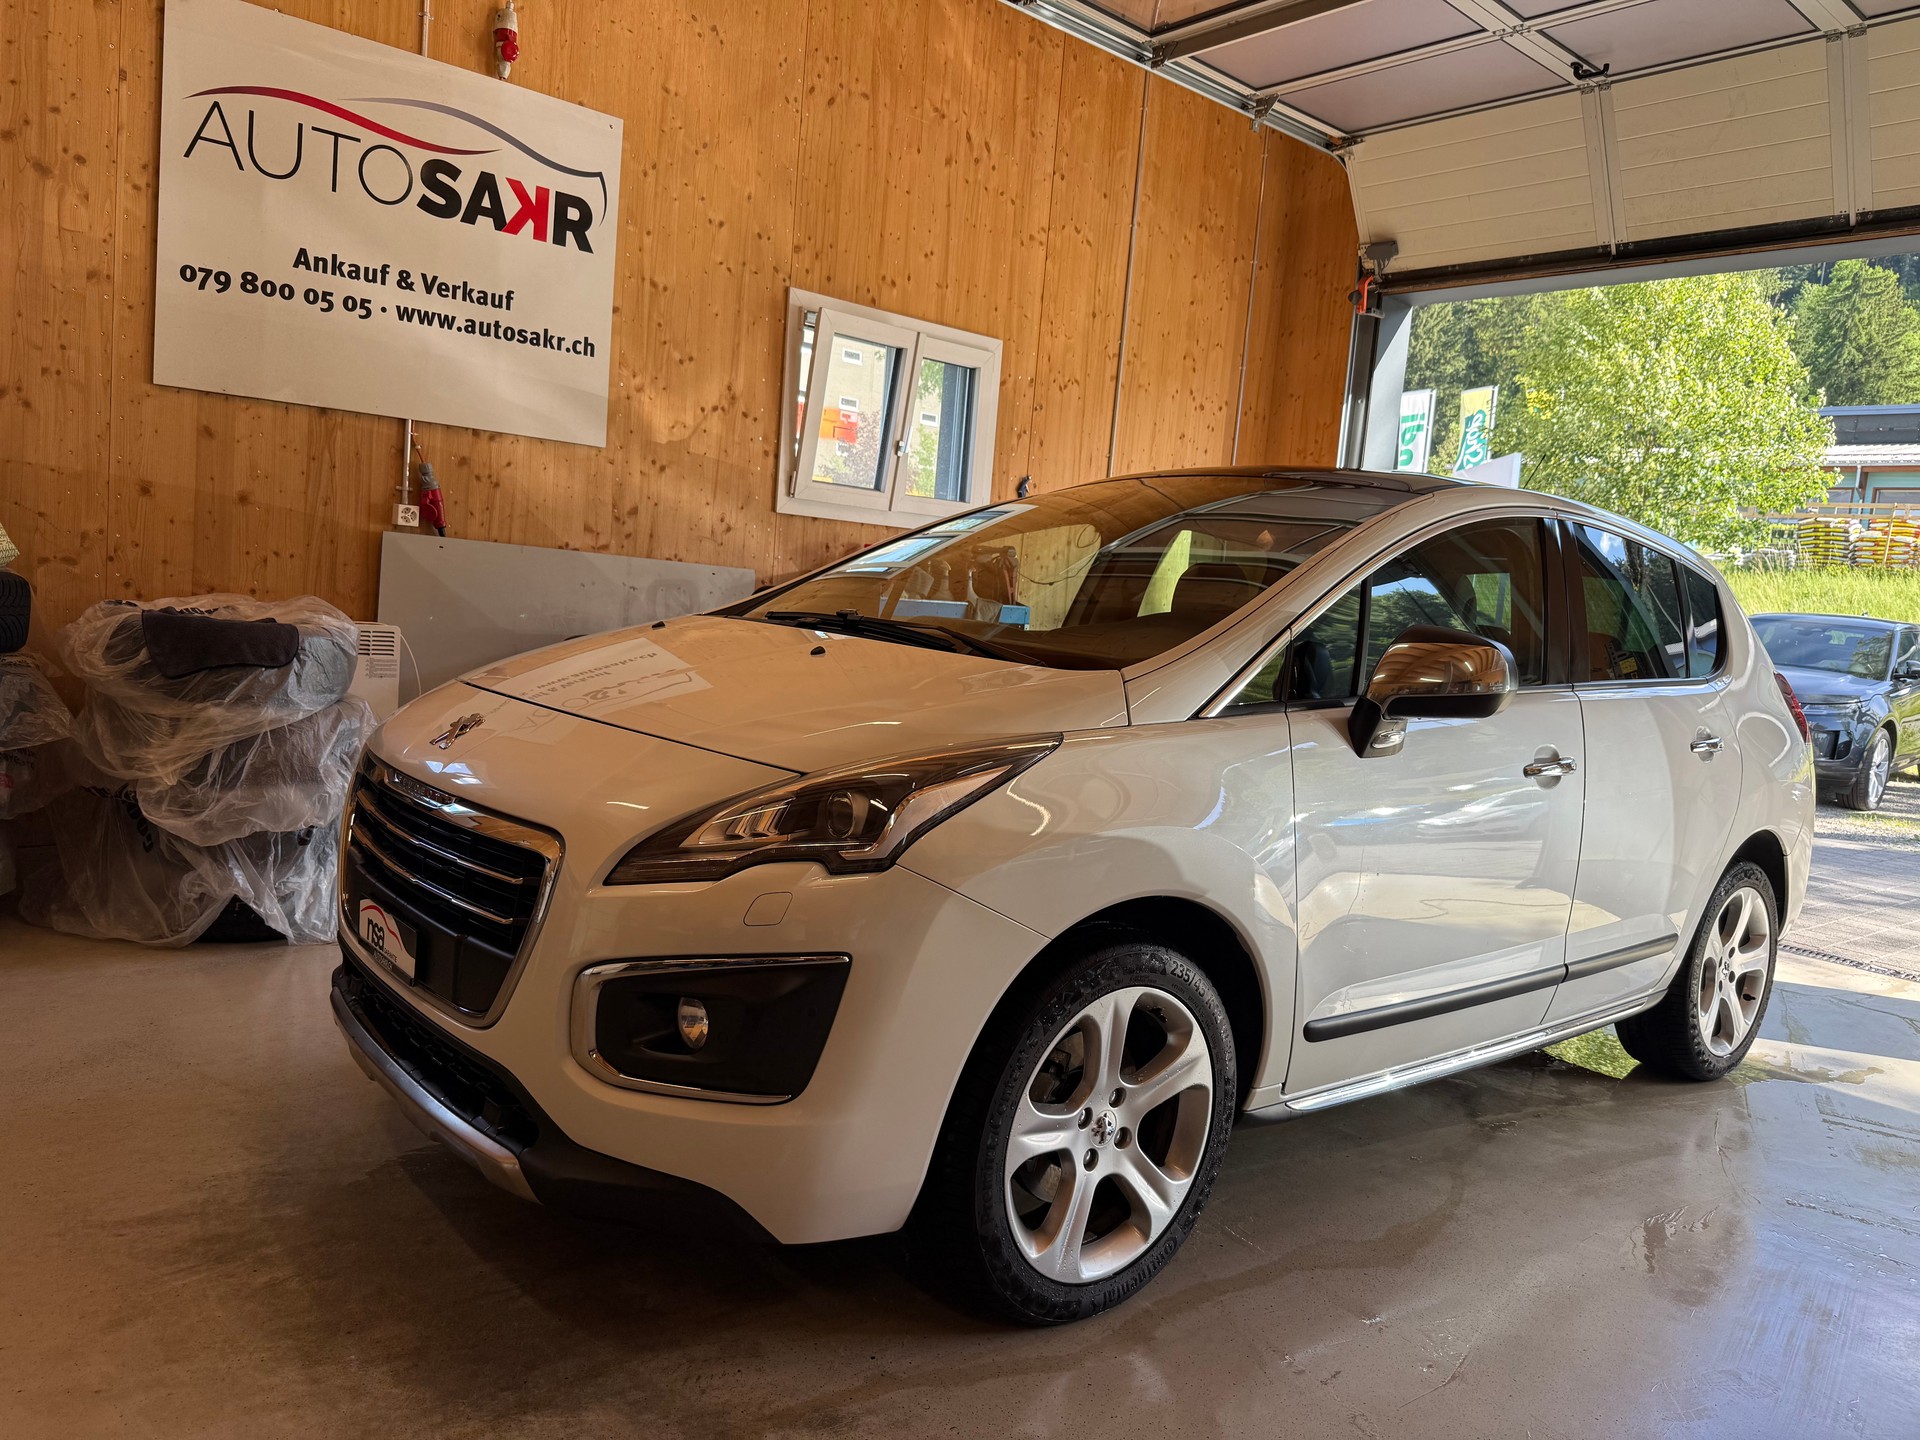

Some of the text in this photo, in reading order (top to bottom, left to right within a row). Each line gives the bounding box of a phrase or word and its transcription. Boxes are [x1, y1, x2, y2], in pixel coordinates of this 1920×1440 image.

[179, 263, 596, 358] 079 800 05 05 www.autosakr.ch
[292, 247, 515, 311] Ankauf & Verkauf
[366, 917, 385, 952] nsa
